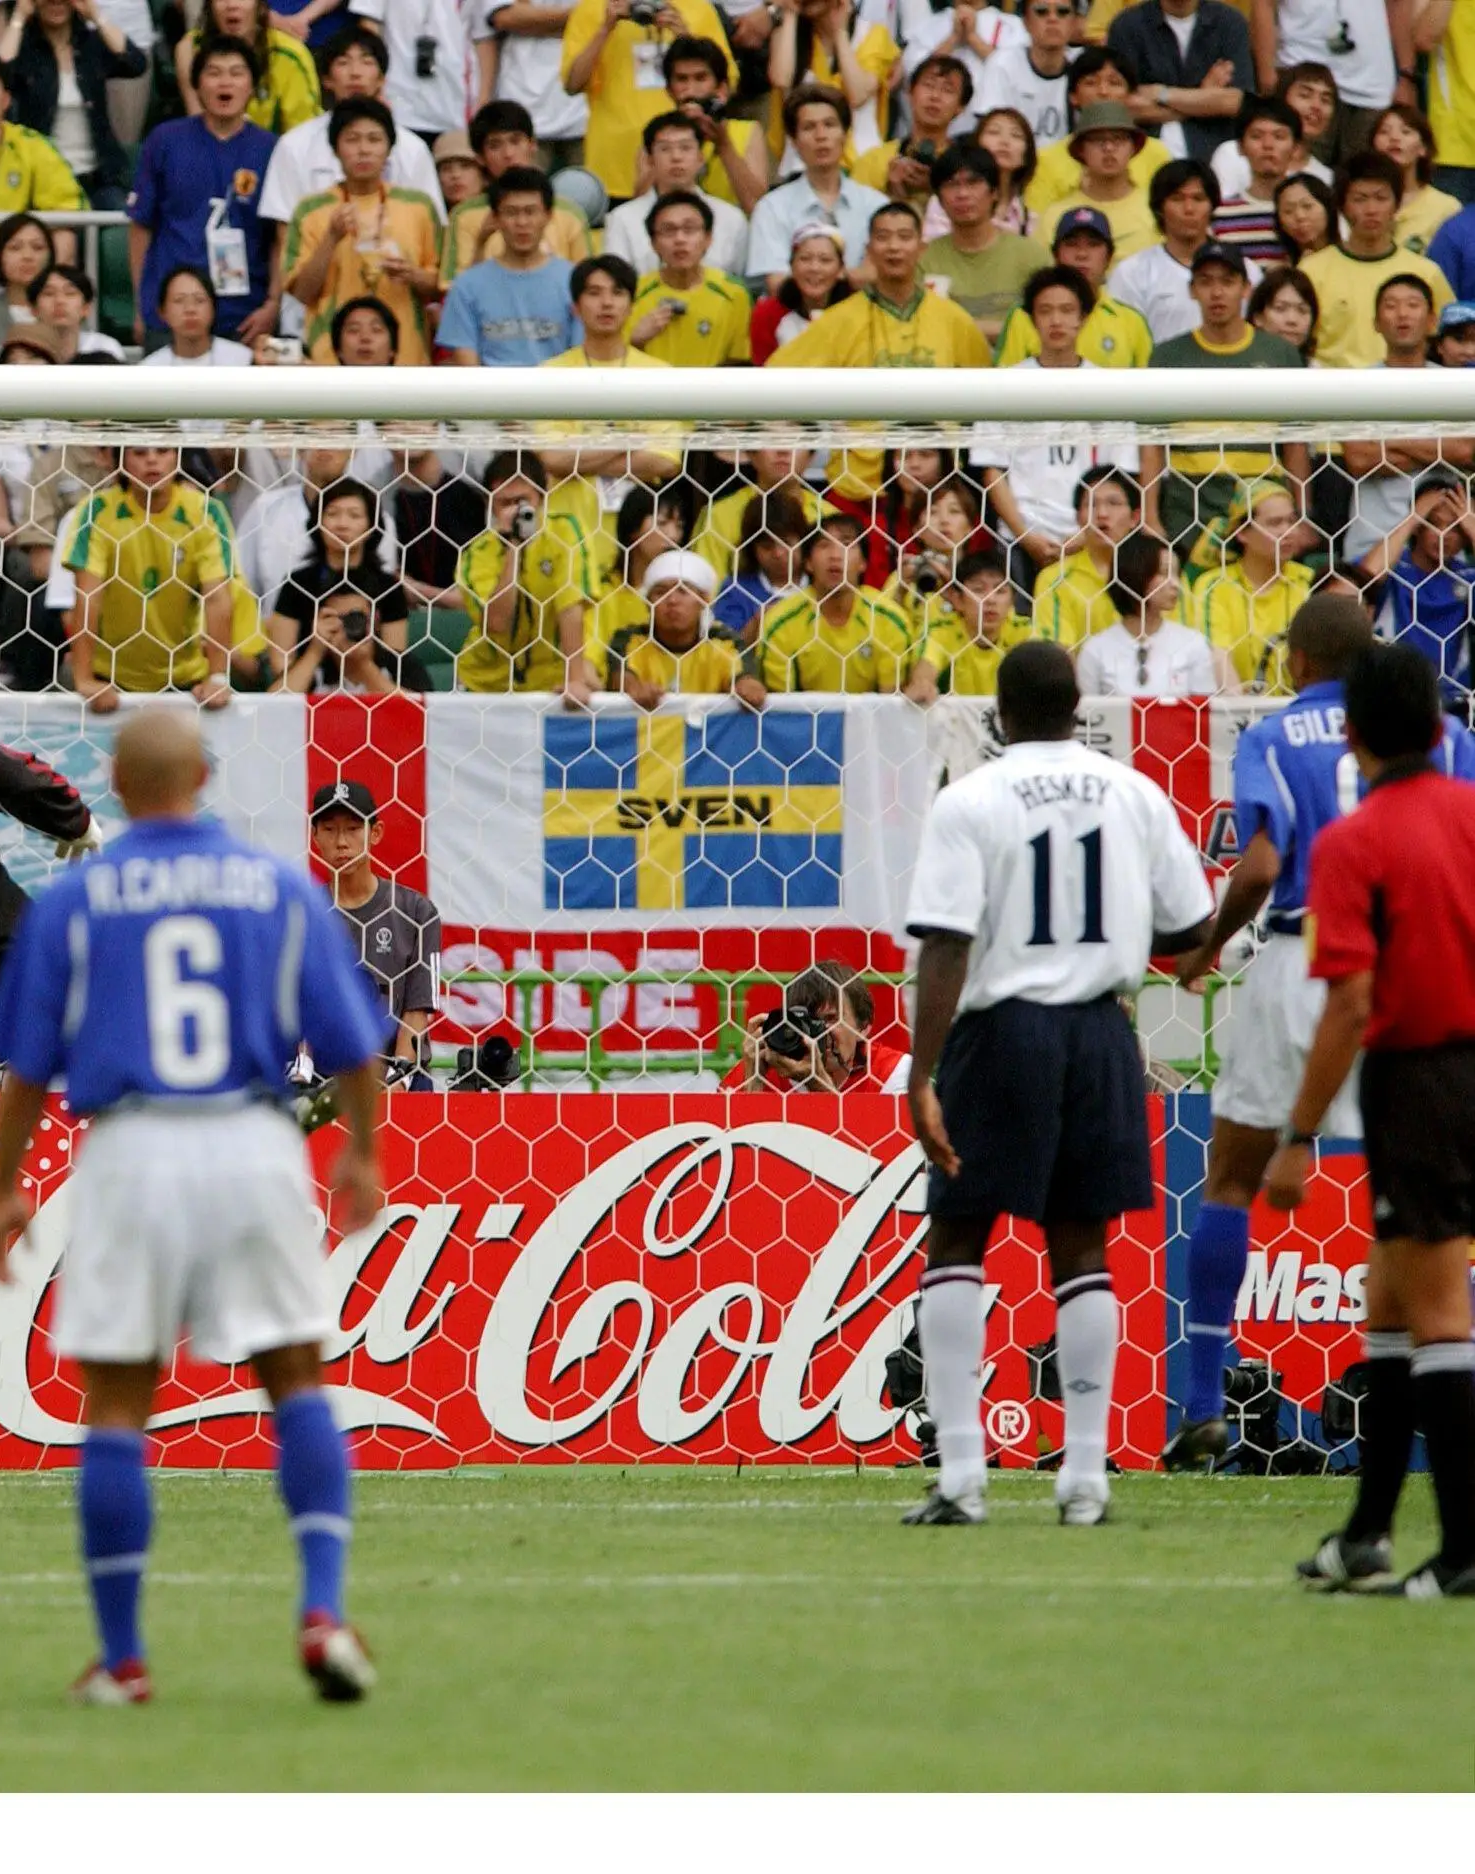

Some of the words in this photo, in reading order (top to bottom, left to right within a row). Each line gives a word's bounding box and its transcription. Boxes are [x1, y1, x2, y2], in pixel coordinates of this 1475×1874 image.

[617, 795, 772, 830] SVEN
[1013, 772, 1111, 810] HESKEY
[84, 854, 279, 915] R.CARLOS
[1026, 825, 1110, 946] 11
[143, 913, 231, 1090] 6
[439, 943, 700, 1031] SIDE
